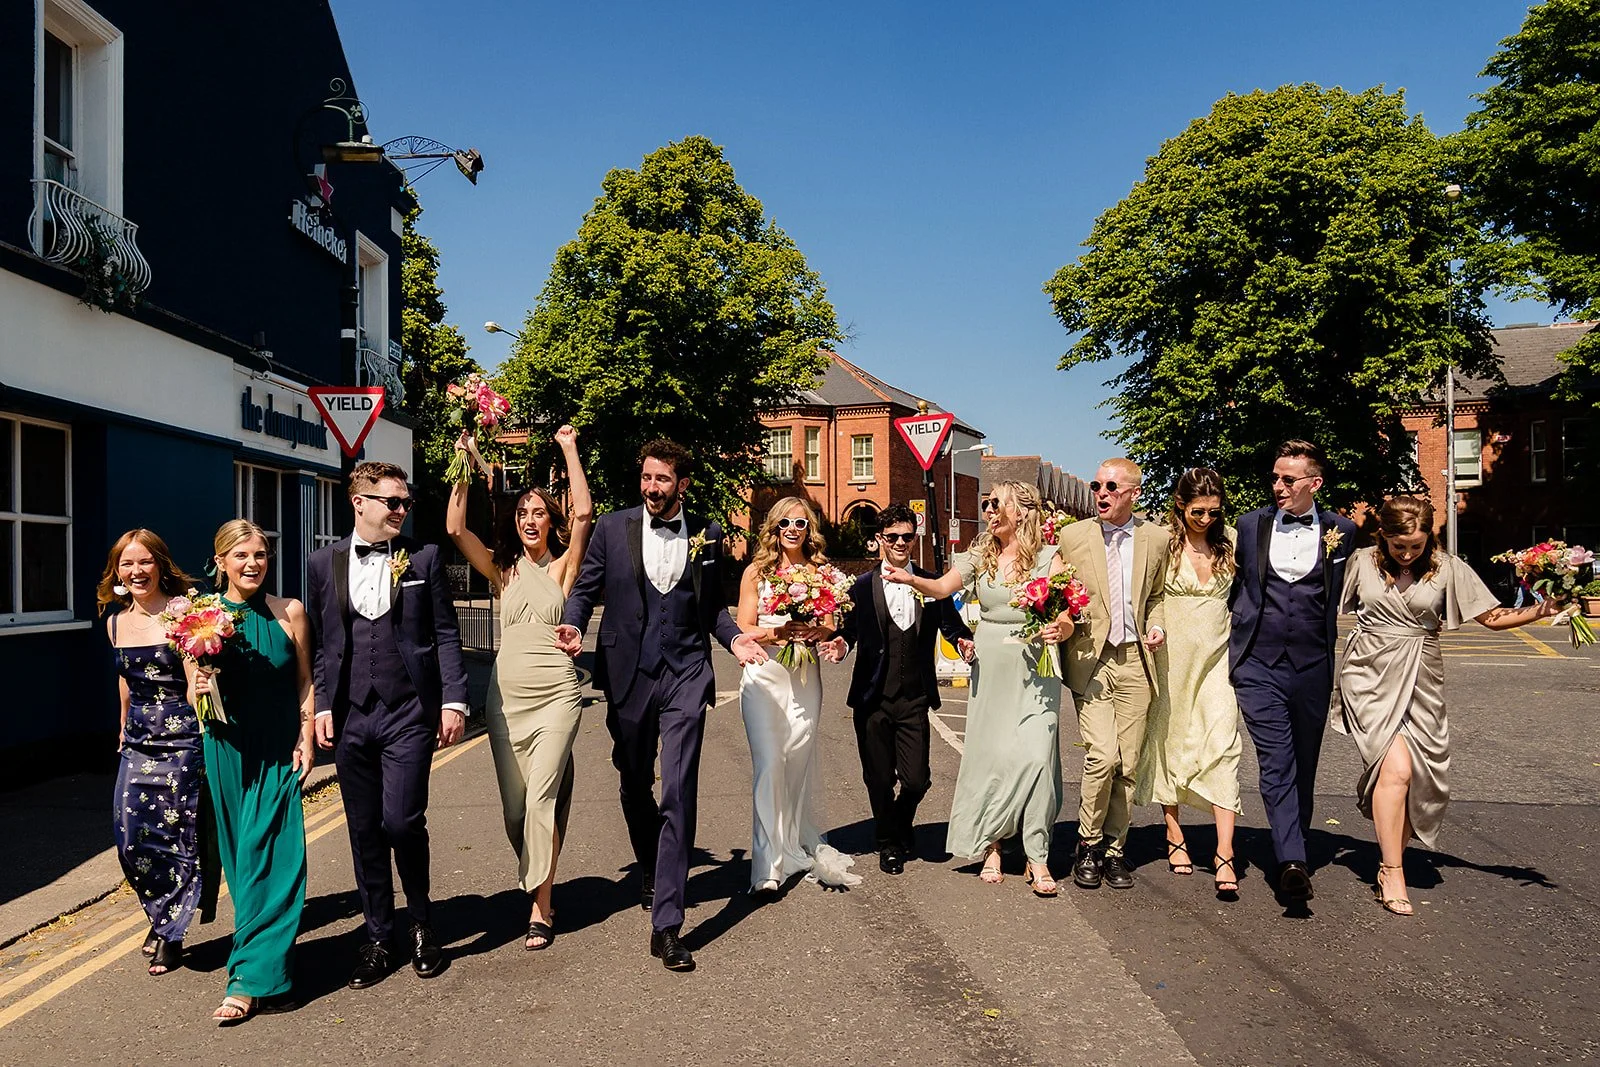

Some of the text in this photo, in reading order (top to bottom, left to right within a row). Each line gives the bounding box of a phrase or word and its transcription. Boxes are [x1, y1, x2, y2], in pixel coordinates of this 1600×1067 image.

[324, 396, 374, 411] YIELD
[241, 385, 328, 450] the donnybrook
[906, 421, 942, 436] YIELD
